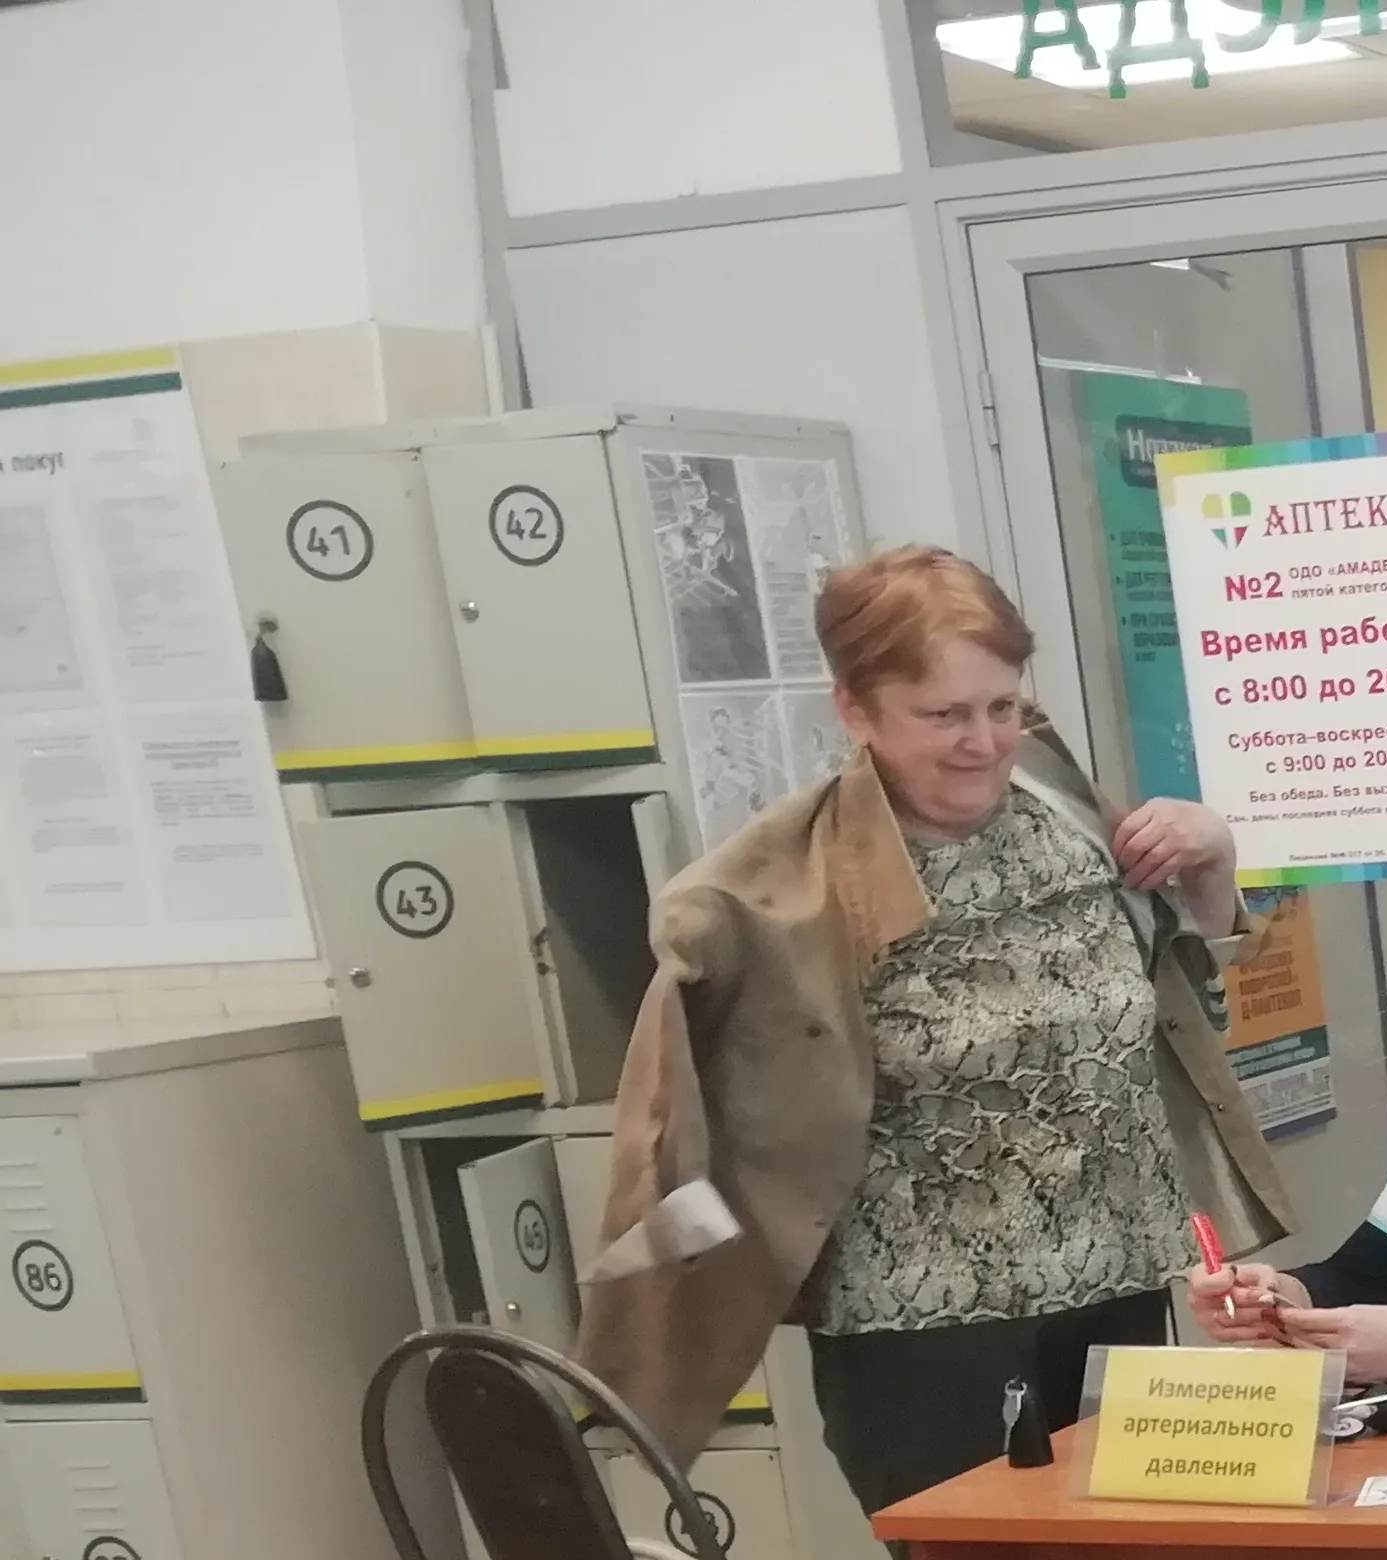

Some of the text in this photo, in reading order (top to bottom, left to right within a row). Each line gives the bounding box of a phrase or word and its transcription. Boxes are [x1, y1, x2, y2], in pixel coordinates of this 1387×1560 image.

[505, 507, 548, 540] 42
[306, 525, 352, 557] 41
[1224, 571, 1284, 601] №2
[1288, 563, 1323, 581] ОДО
[1291, 582, 1335, 601] пятой
[1201, 628, 1307, 662] Время
[1214, 685, 1232, 707] с
[1244, 675, 1308, 704] 8:00
[1319, 675, 1357, 703] до
[1283, 753, 1326, 773] 9:00
[1333, 755, 1358, 772] до
[1250, 790, 1277, 803] Без
[1281, 786, 1329, 802] обеда.
[1333, 785, 1360, 798] Без
[395, 885, 437, 919] 43
[25, 1262, 62, 1293] 86
[1148, 1377, 1277, 1402] Измерение
[1123, 1416, 1294, 1441] артериального
[1145, 1453, 1257, 1479] давления
